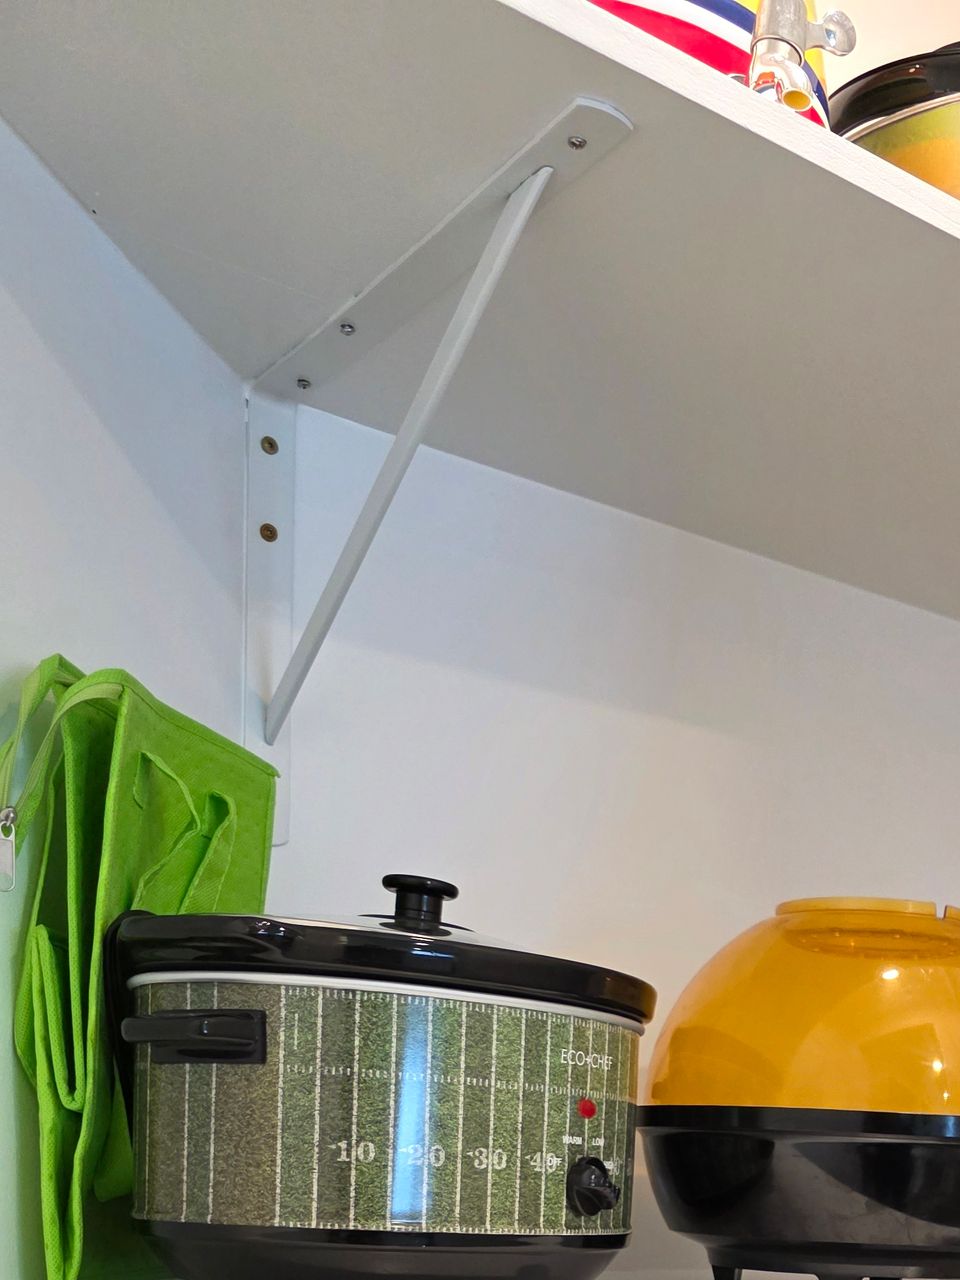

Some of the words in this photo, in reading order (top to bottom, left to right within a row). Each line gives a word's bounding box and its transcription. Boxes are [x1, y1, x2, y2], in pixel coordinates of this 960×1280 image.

[336, 1139, 376, 1163] 10
[562, 1135, 583, 1145] WARM
[407, 1143, 447, 1167] 20
[473, 1147, 508, 1170] 30
